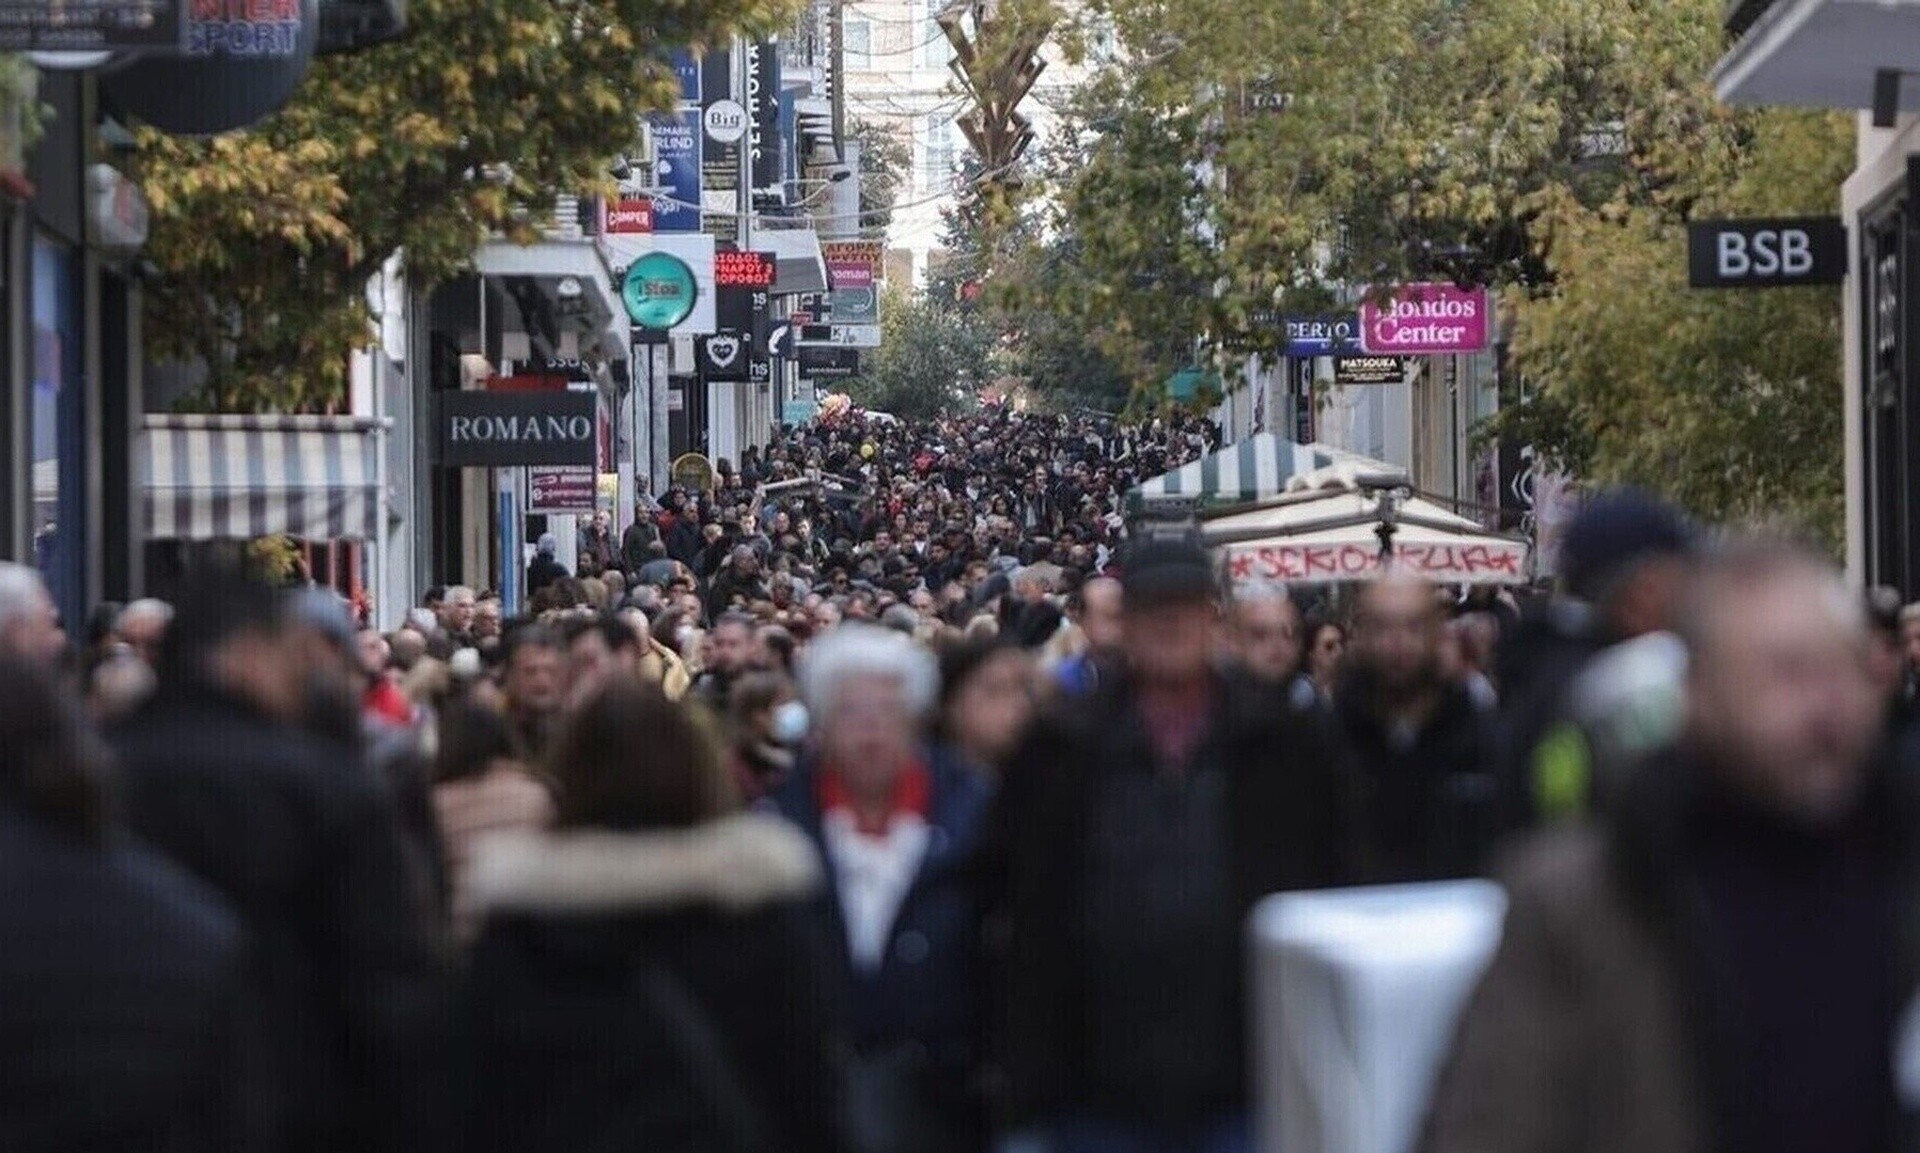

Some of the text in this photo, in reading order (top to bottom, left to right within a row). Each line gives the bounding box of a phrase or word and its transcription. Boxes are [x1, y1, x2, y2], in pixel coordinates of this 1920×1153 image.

[1717, 229, 1813, 276] BSB
[1374, 319, 1466, 344] Center
[1340, 358, 1398, 369] MATSOUKA
[450, 415, 592, 442] ROMANO
